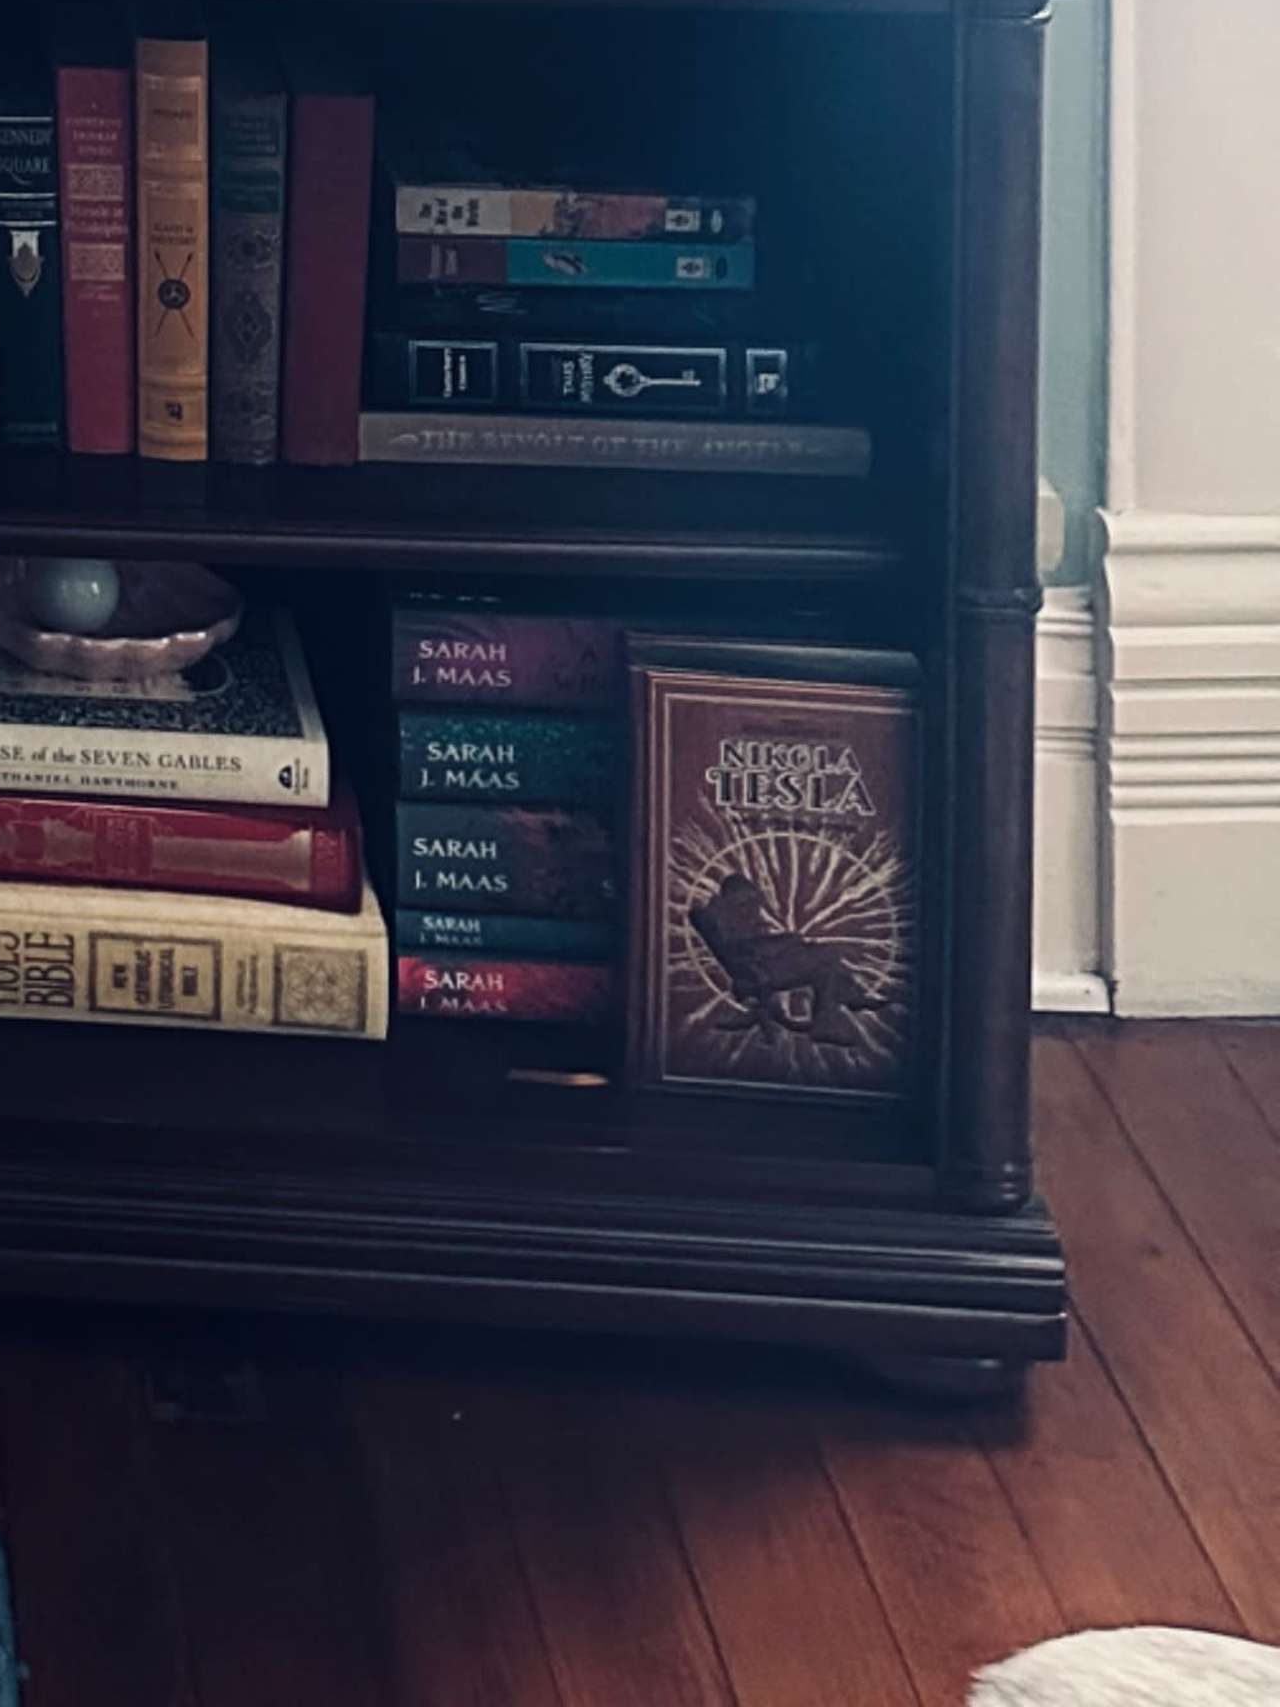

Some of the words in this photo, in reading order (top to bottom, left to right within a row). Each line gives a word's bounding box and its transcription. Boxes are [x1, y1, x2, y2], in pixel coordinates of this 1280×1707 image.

[418, 428, 473, 451] THE
[483, 431, 586, 453] REVOLT
[592, 434, 628, 456] OF
[632, 435, 690, 458] THE
[419, 639, 507, 663] SARAH
[435, 667, 513, 688] MAAS
[30, 746, 47, 764] of
[51, 746, 78, 765] the
[80, 748, 153, 769] SEVEN
[157, 752, 243, 773] GABLES
[427, 741, 516, 765] SARAH
[719, 738, 864, 778] NIKOLA
[80, 774, 180, 790] HAWTHORNE
[444, 769, 521, 790] MAAS
[706, 767, 877, 817] TESLA
[412, 837, 498, 860] SARAH
[435, 870, 509, 893] MAAS
[421, 915, 481, 934] SARAH
[24, 930, 76, 1010] BIBLE
[423, 970, 505, 992] SARAH
[440, 996, 509, 1013] MAAS
